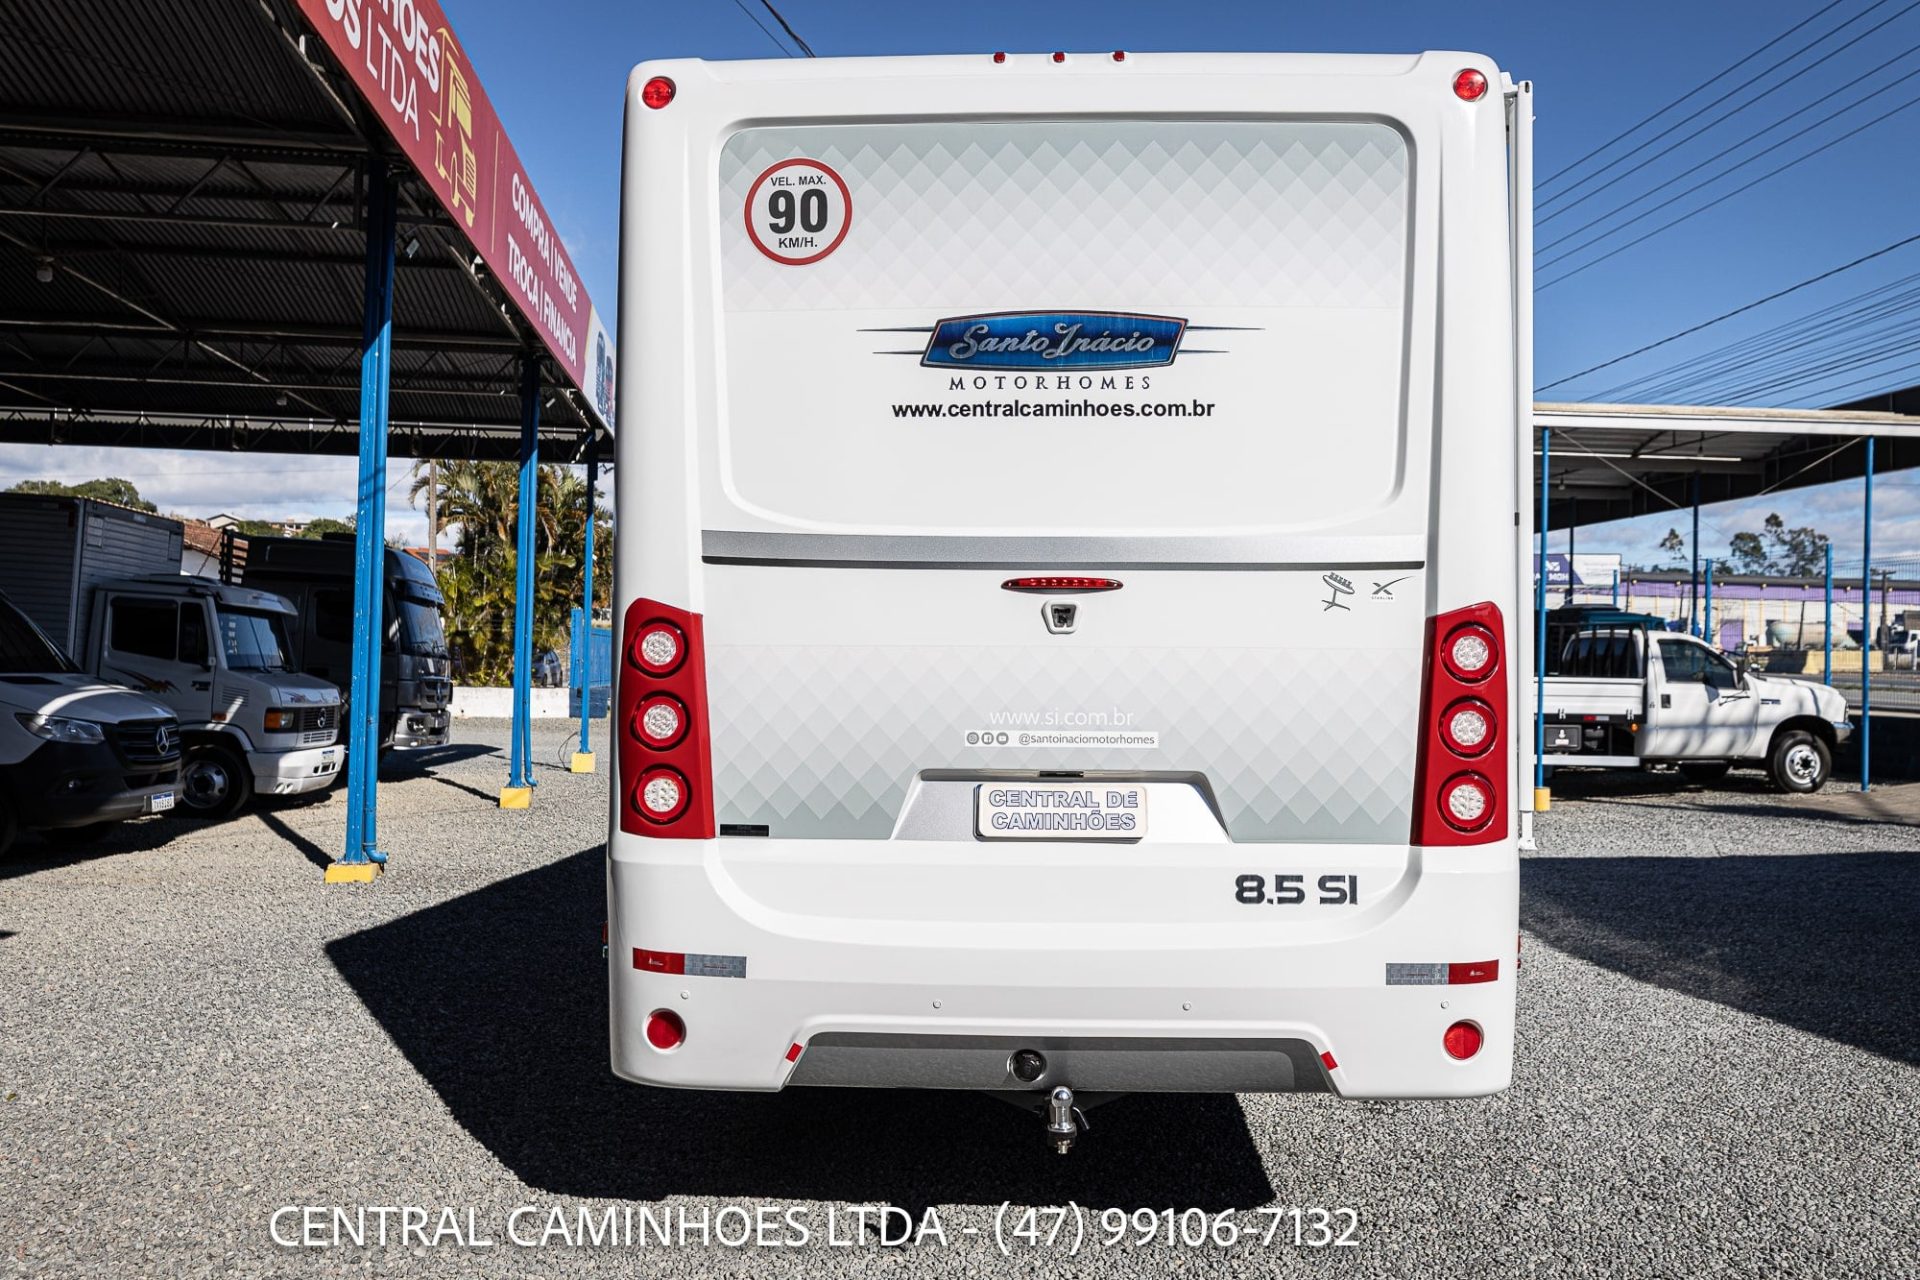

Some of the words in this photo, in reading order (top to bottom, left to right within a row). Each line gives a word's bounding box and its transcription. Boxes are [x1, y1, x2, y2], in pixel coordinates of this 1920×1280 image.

[366, 7, 419, 141] LTDA
[770, 176, 796, 187] VEL.
[798, 174, 827, 186] MAX.
[768, 188, 828, 234] 90
[511, 172, 550, 267] COMPRA
[554, 247, 577, 313] VENDE
[778, 236, 818, 248] KM/H.
[508, 233, 539, 313] TROCA
[543, 293, 577, 367] FINANCIA
[949, 323, 1050, 360] Santo
[1041, 322, 1156, 359] Inácio
[949, 375, 1151, 391] MOTORHOMES
[891, 399, 1216, 418] www.centralcaminhoes.com.br
[989, 706, 1134, 727] www.si.com.br
[1018, 732, 1155, 746] @santoinaciomotorhomes
[988, 789, 1100, 808] CENTRAL
[991, 809, 1136, 831] CAMINHÕES
[1235, 874, 1306, 905] 8.5
[1317, 874, 1358, 905] SI
